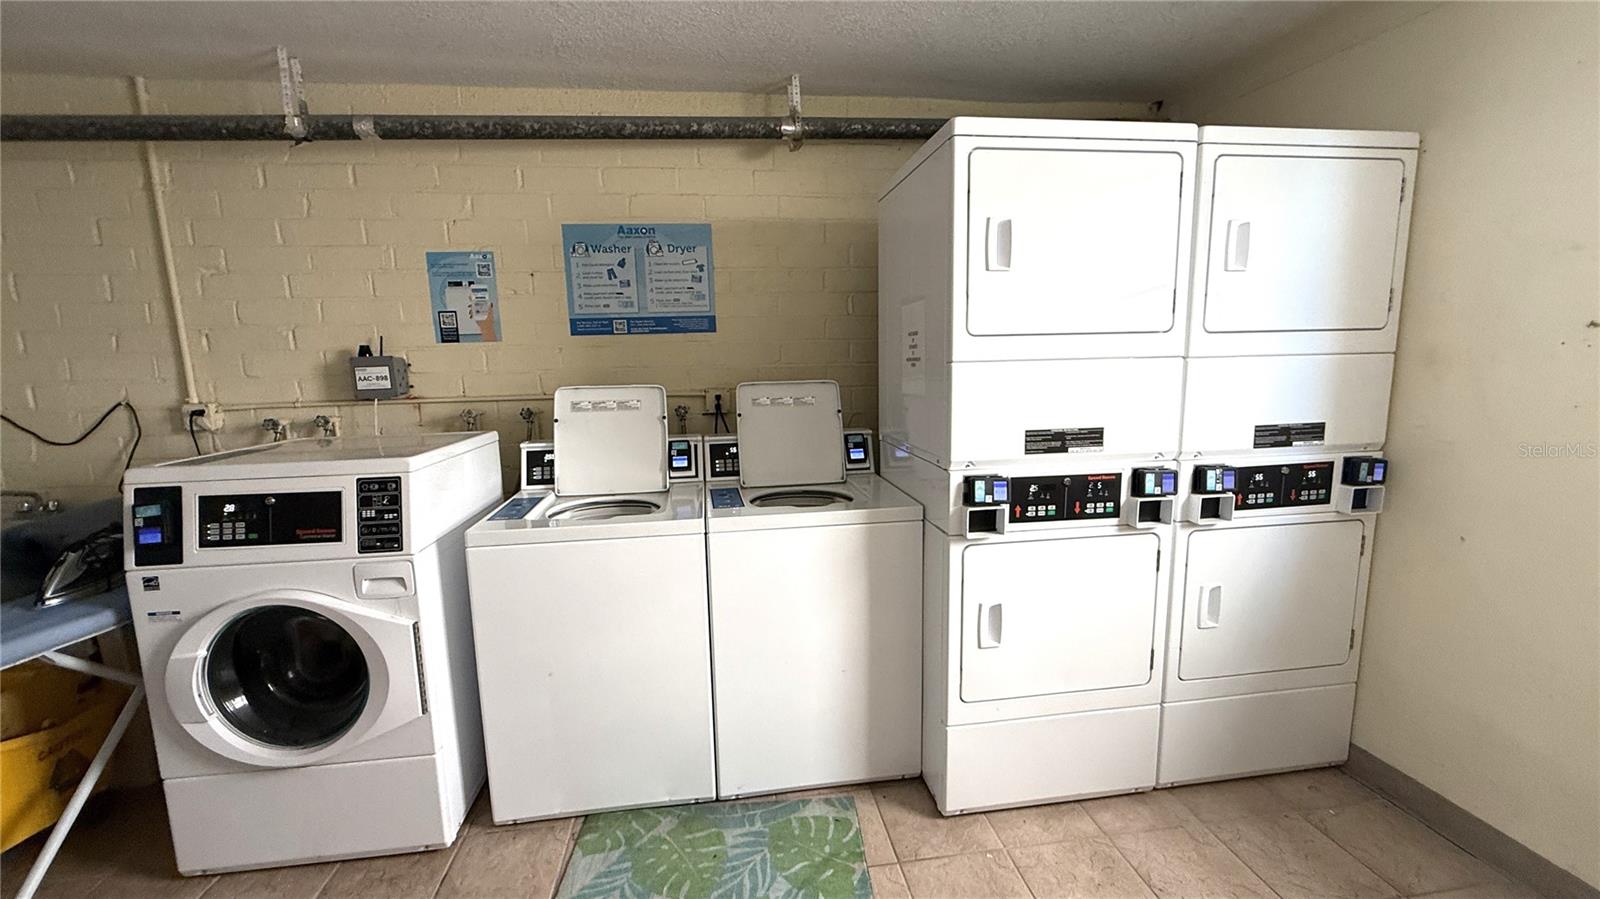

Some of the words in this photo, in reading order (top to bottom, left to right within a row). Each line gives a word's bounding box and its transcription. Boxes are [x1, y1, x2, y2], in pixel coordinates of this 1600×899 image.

[617, 225, 656, 235] Aaxon
[590, 244, 632, 254] Washer
[667, 244, 697, 255] Dryer
[357, 374, 389, 382] AAC-898
